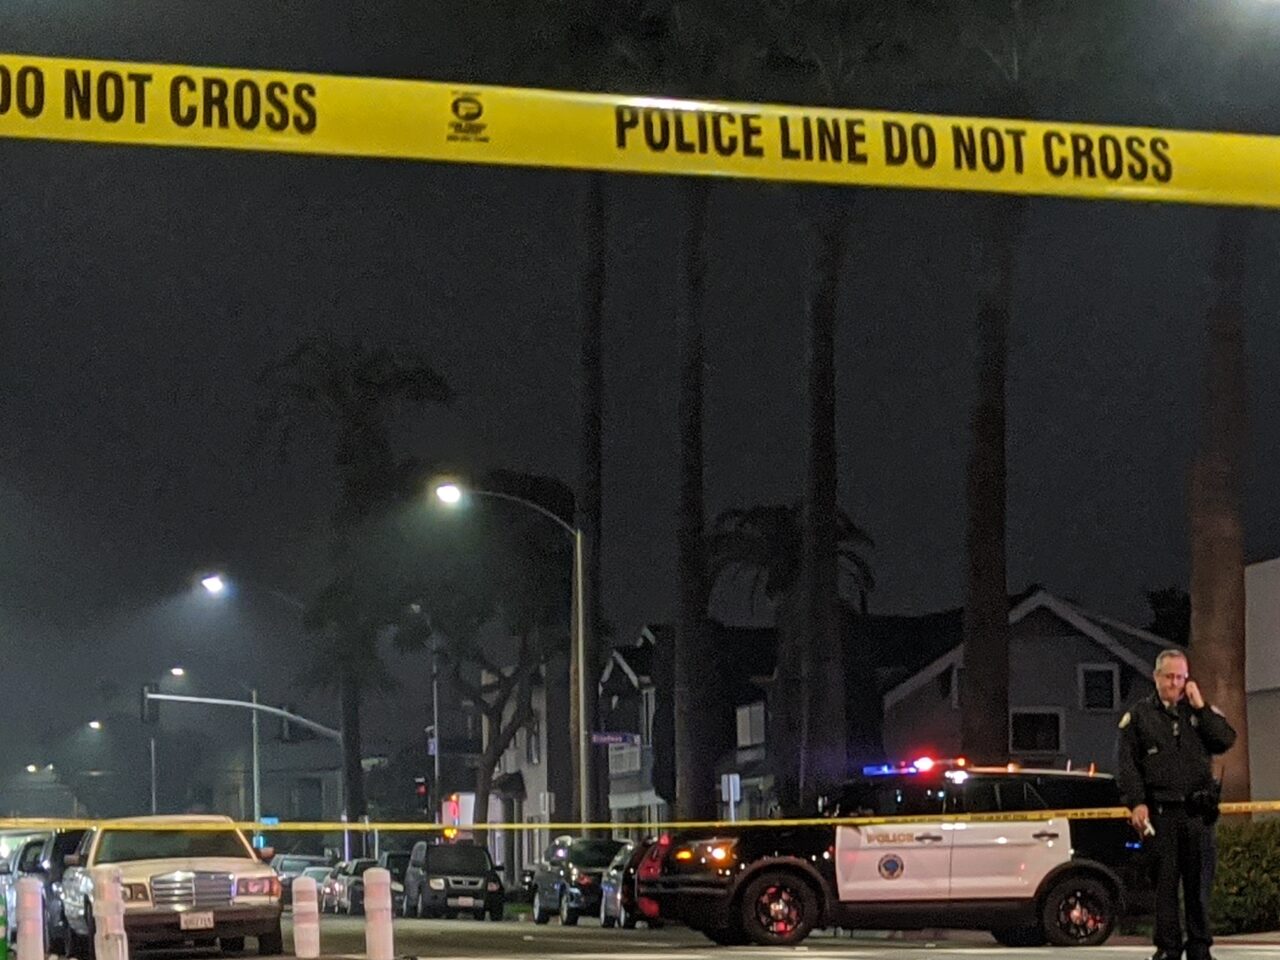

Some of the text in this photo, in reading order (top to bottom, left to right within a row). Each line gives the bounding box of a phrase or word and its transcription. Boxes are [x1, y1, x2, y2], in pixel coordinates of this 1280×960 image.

[65, 69, 153, 124] NOT
[170, 75, 317, 135] CROSS
[616, 104, 1172, 183] POLICE LINE DO NOT CROSS
